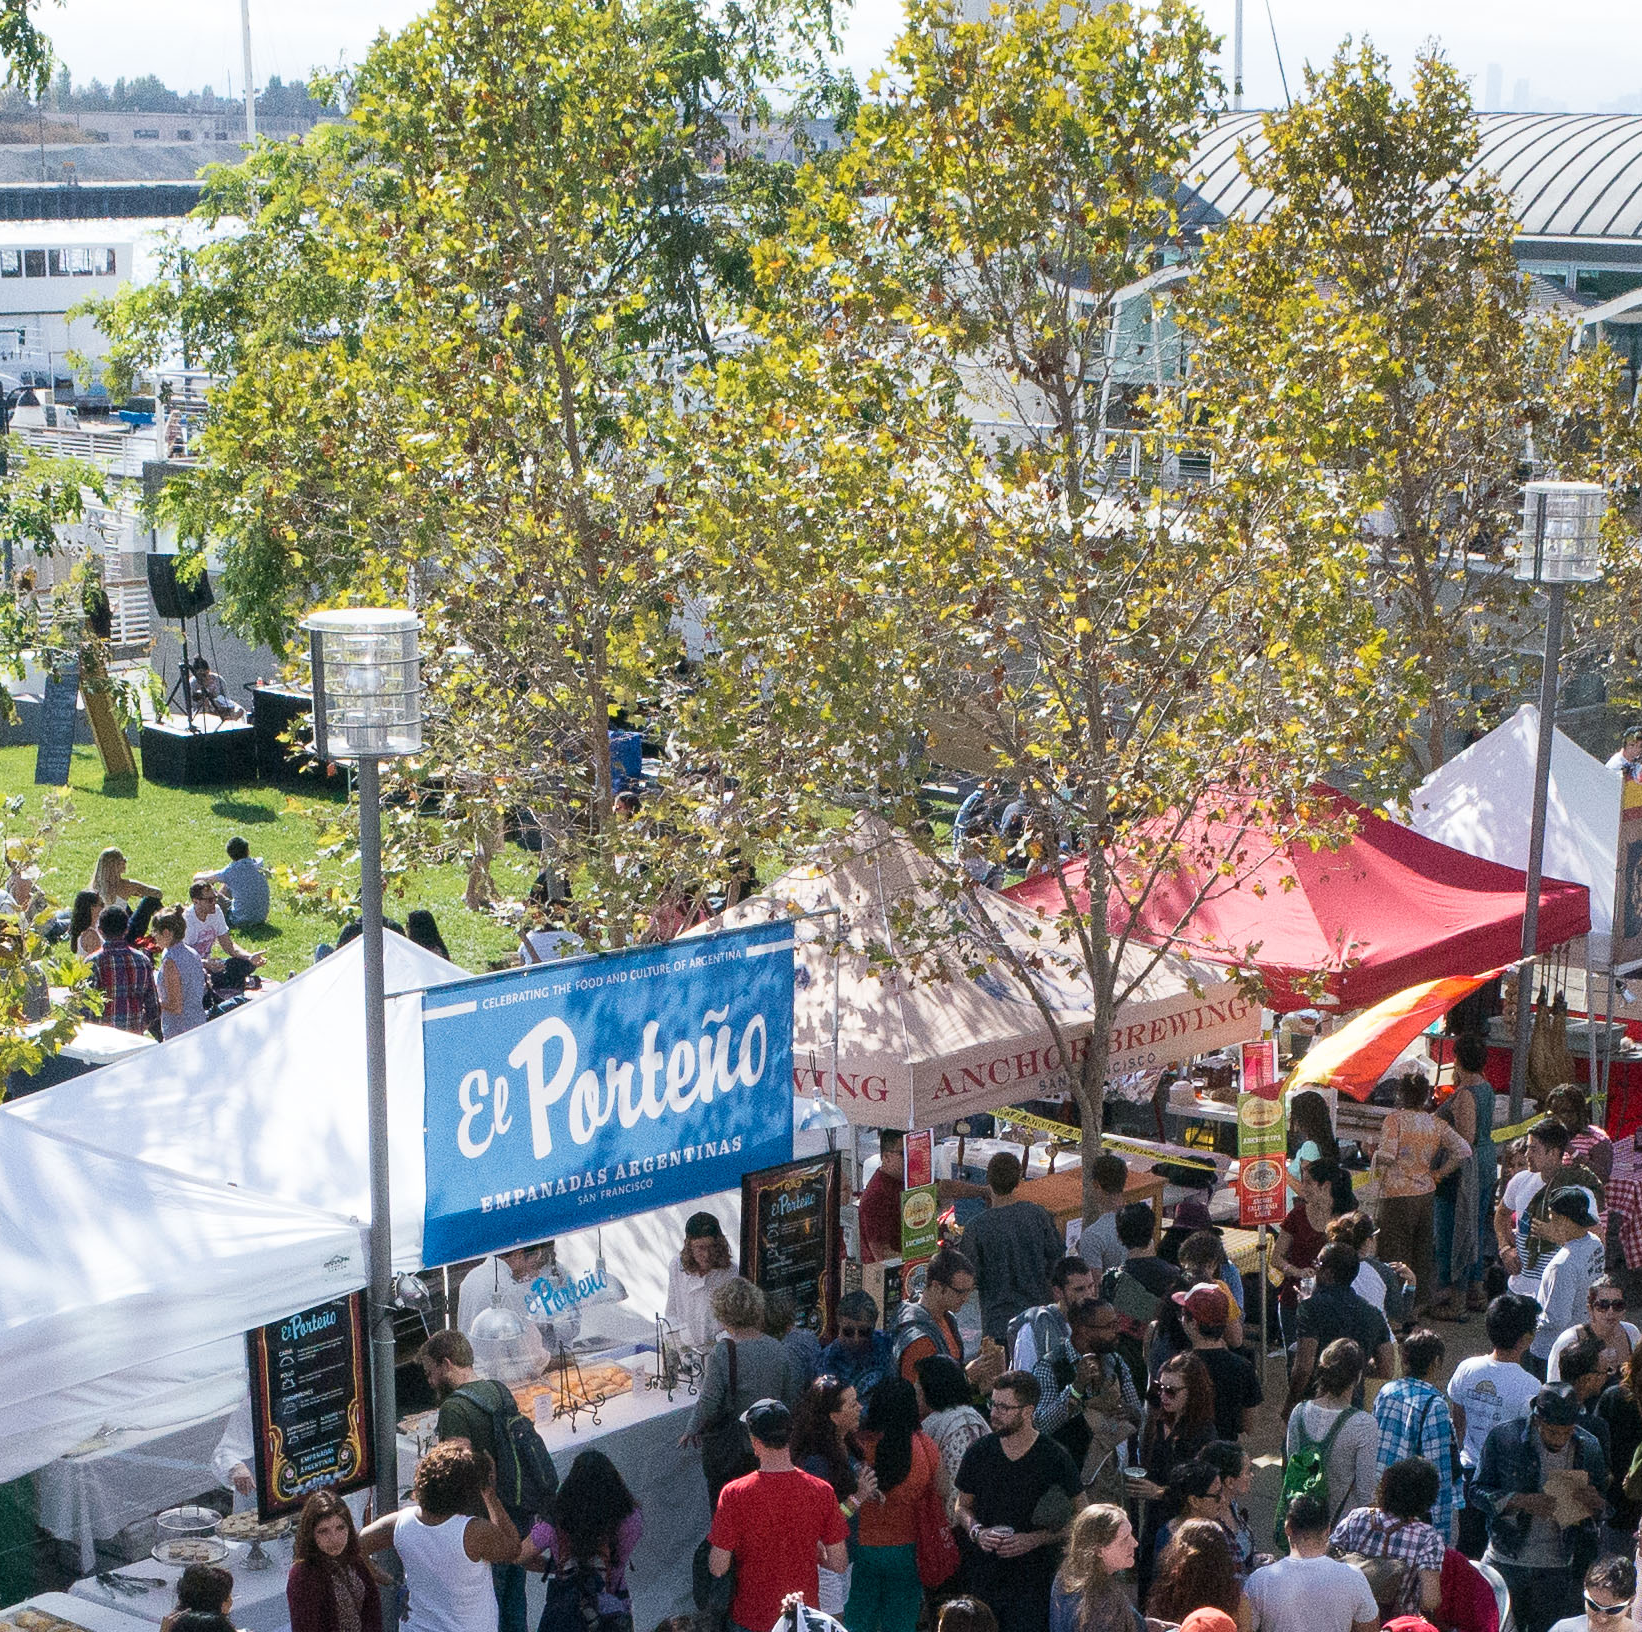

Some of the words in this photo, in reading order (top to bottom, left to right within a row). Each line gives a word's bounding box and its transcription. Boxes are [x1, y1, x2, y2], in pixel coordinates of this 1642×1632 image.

[482, 986, 550, 1009] CELEBRATING
[553, 981, 572, 995] THE
[575, 975, 604, 991] FOOD
[606, 970, 628, 985] AND
[630, 960, 671, 981] CULTURE
[673, 958, 687, 973] OF
[689, 948, 742, 969] ARGENTINA
[932, 1036, 1092, 1100] ANCHOR
[1108, 995, 1250, 1054] BREWING
[457, 1069, 513, 1159] El
[508, 1004, 767, 1160] Porteño
[480, 1167, 608, 1214] EMPANADAS
[615, 1134, 743, 1180] ARGENTINAS
[577, 1193, 597, 1206] SAN
[600, 1179, 654, 1202] FRANCISCO
[531, 1268, 608, 1316] Porteño
[289, 1310, 337, 1340] Porteño
[300, 1447, 334, 1464] EMPANADAS
[300, 1456, 335, 1473] ARGENTINAS
